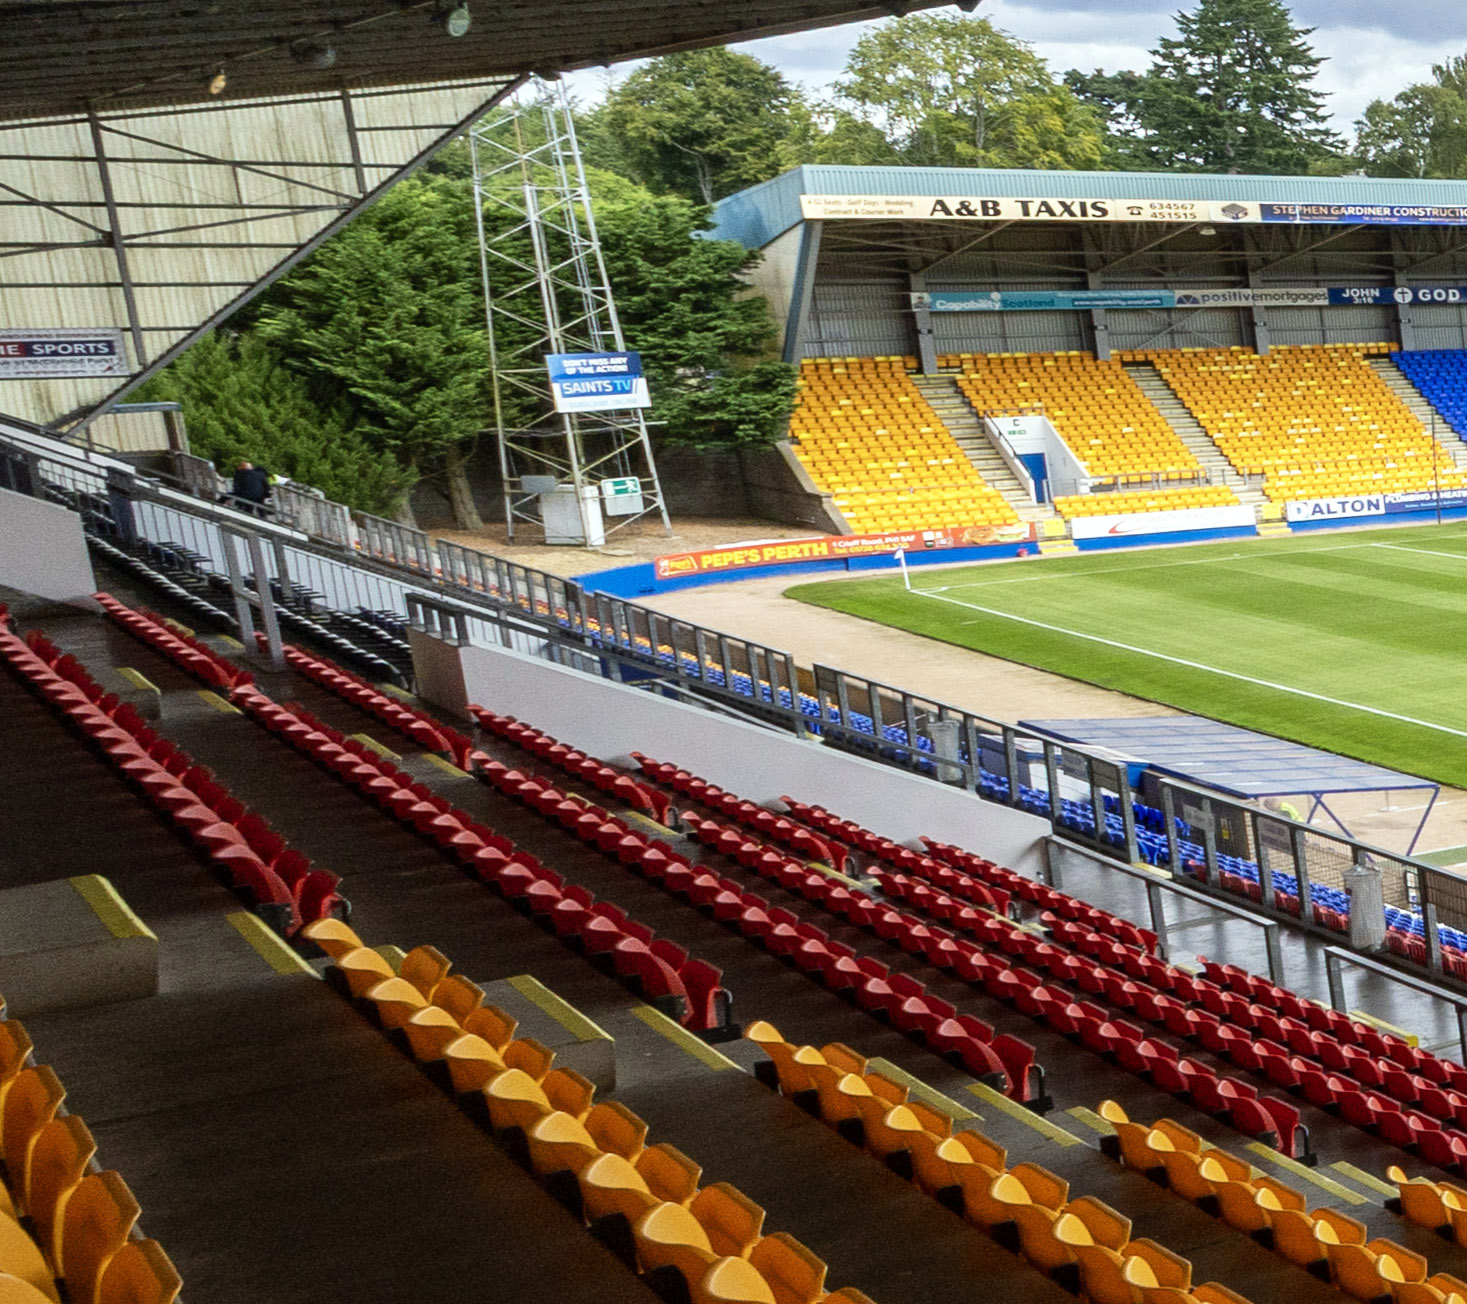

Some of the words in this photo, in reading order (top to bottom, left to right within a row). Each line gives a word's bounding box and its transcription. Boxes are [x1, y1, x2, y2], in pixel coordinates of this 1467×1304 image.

[930, 199, 1002, 217] A&B
[1014, 200, 1109, 218] TAXIS
[1150, 202, 1195, 210] 634567
[1273, 205, 1328, 215] STEPHEN
[1330, 206, 1391, 216] GARDINER
[1342, 288, 1379, 298] JOHN
[1418, 288, 1459, 301] GOD
[32, 343, 110, 355] SPORTS
[562, 380, 612, 394] SAINTS
[614, 380, 631, 391] TV
[701, 550, 761, 569] PEPE'S
[763, 542, 828, 562] PERTH
